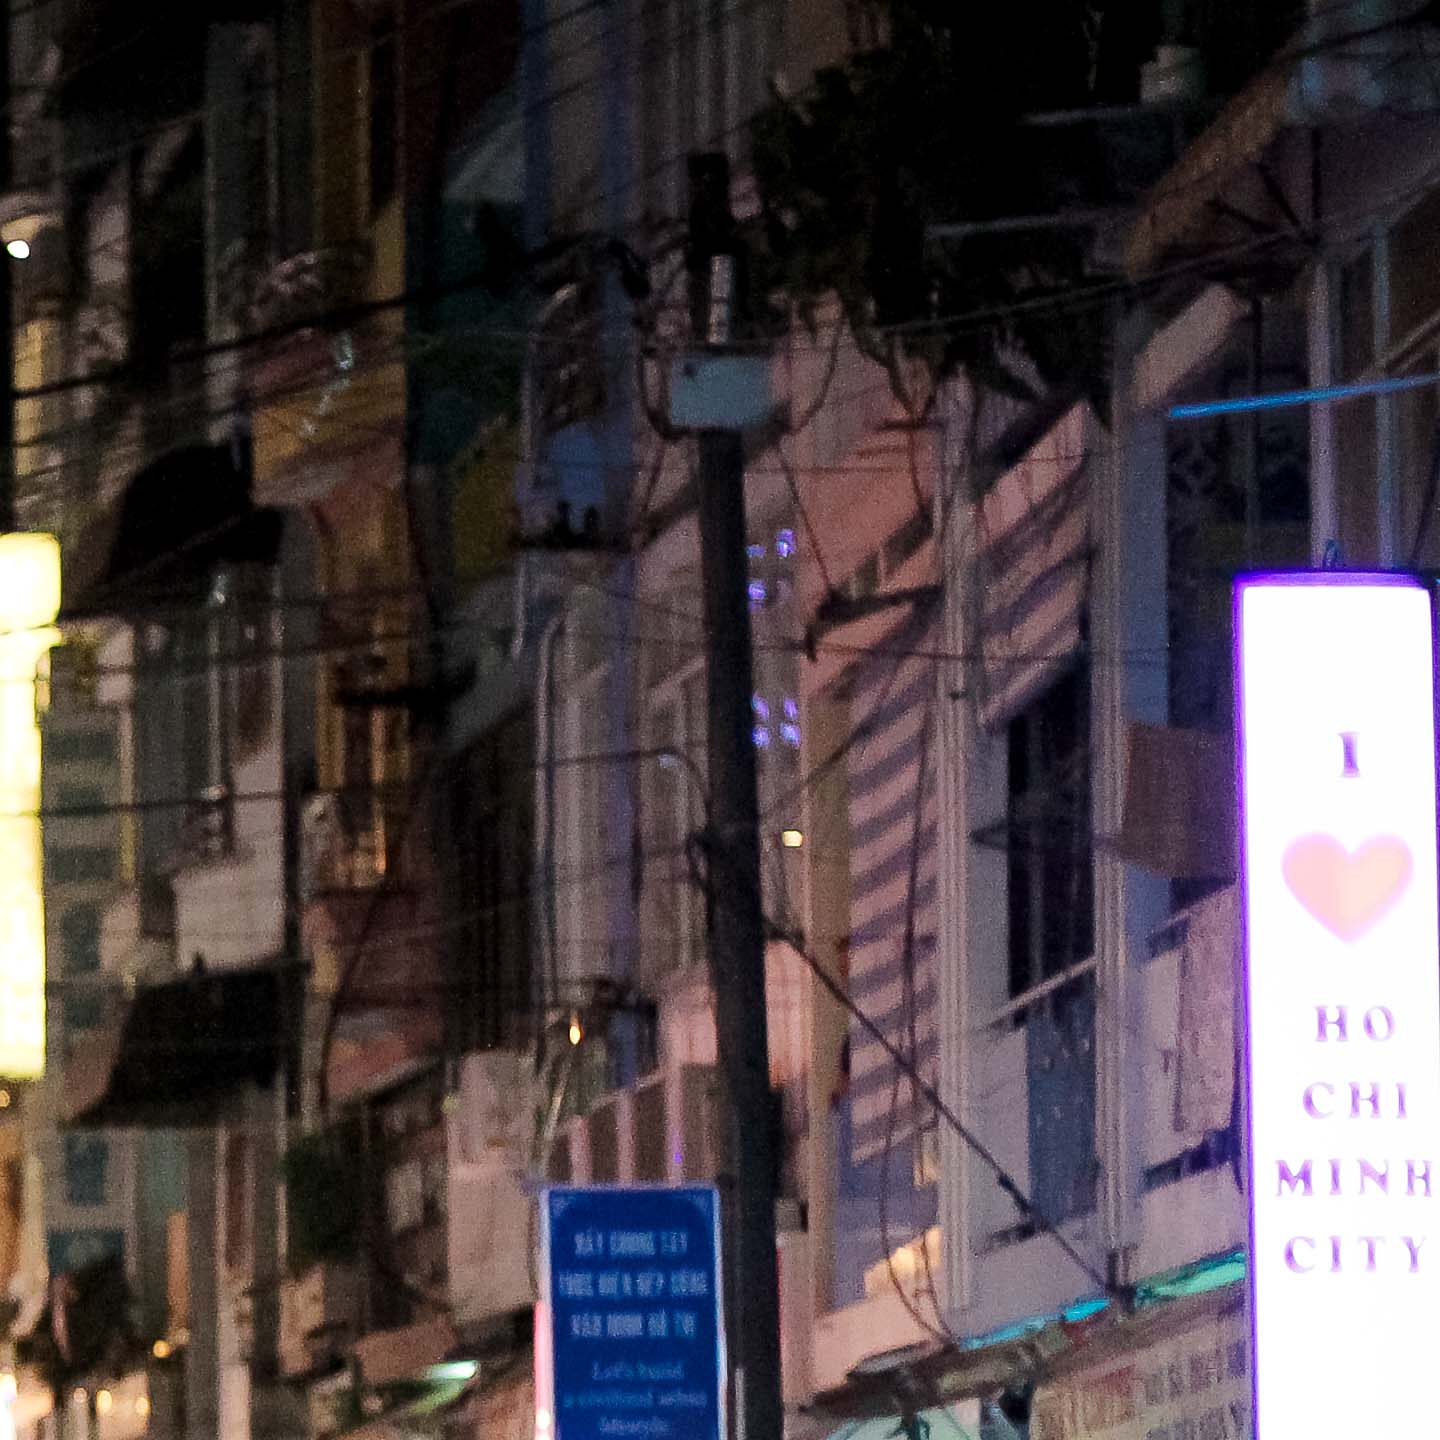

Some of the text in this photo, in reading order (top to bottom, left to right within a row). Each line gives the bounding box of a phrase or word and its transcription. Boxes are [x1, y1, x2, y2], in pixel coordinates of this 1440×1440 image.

[1338, 731, 1361, 778] I
[1314, 1004, 1397, 1043] HO
[1302, 1081, 1409, 1120] CHI
[1275, 1157, 1433, 1197] MINH
[1283, 1234, 1428, 1274] CITY
